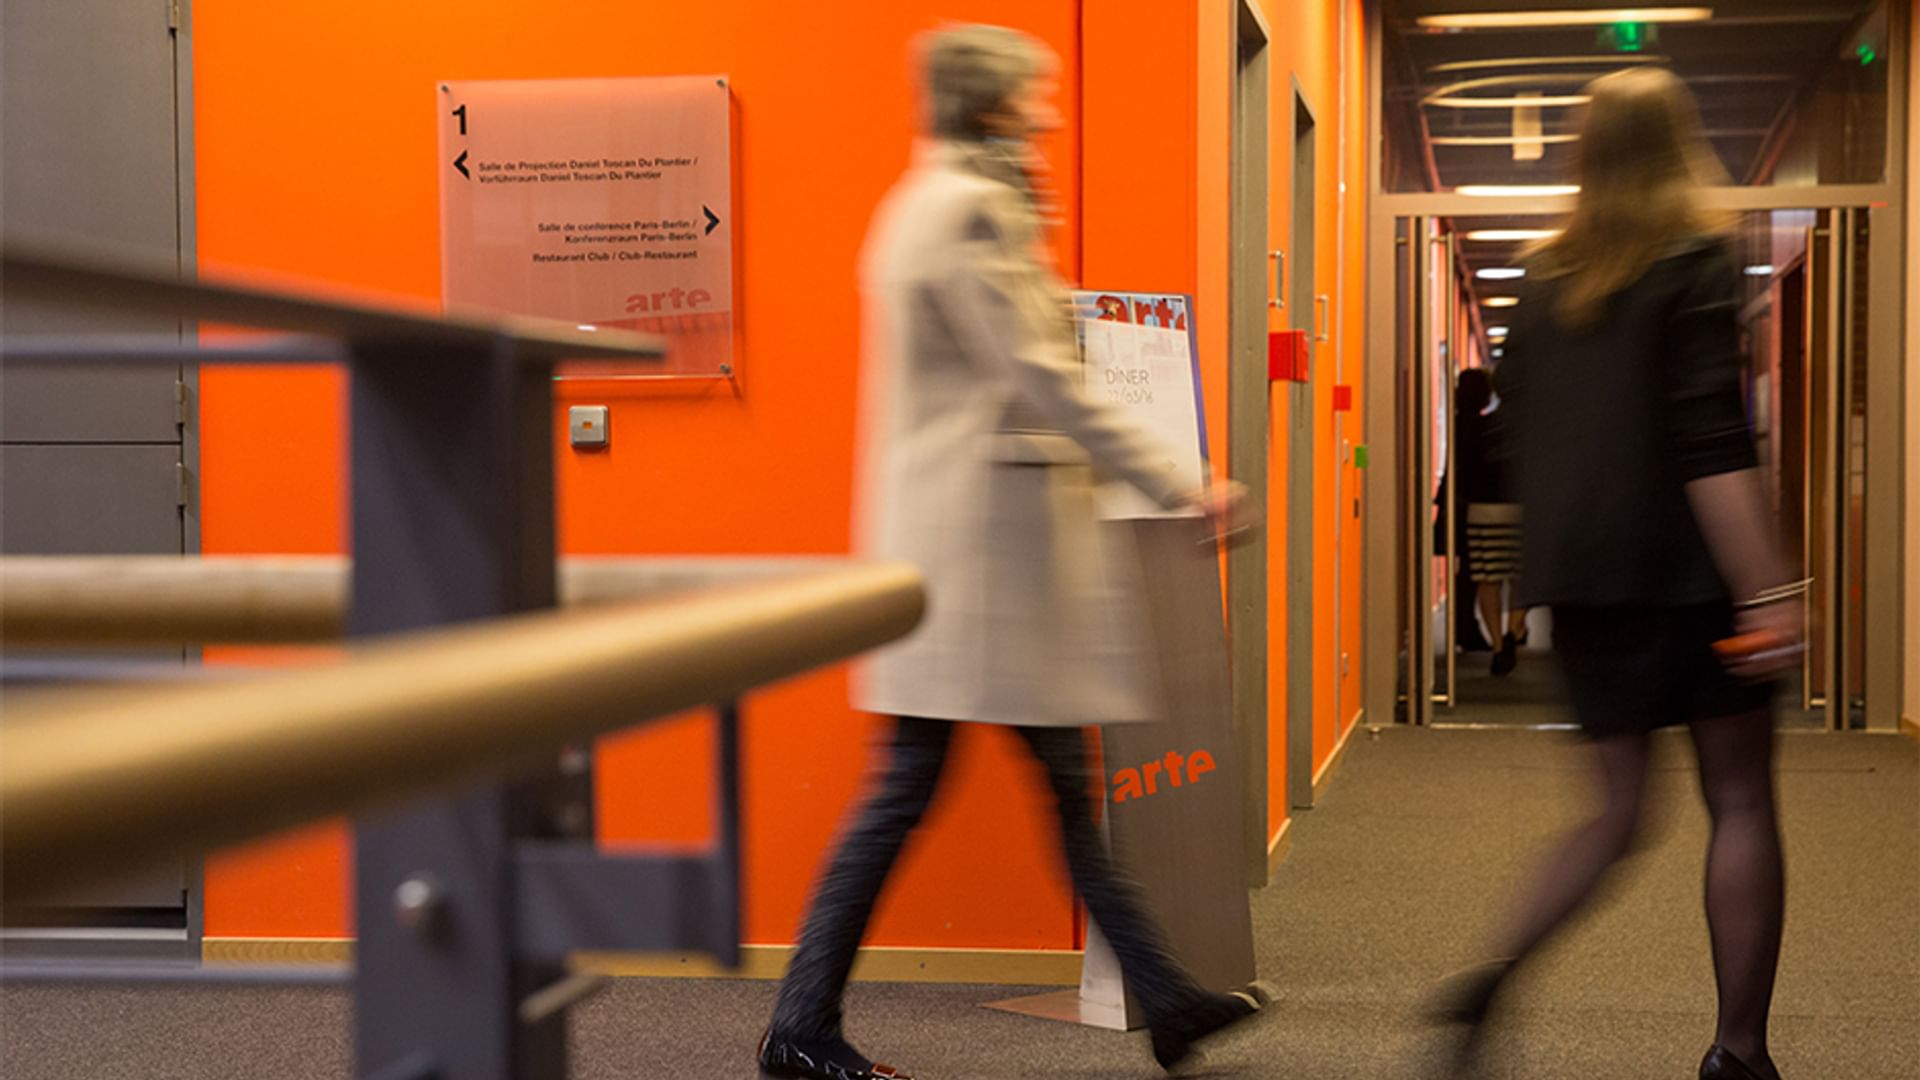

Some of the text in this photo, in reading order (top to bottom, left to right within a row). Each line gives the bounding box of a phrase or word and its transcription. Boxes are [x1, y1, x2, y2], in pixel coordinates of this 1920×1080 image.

[452, 105, 467, 135] 1
[479, 162, 501, 171] Salle
[504, 161, 516, 170] de
[518, 161, 567, 171] Projection
[569, 160, 600, 169] Daniel
[602, 158, 636, 168] Toscan
[638, 158, 653, 167] Du
[479, 170, 662, 183] Vorführraum Daniel Toscan Du Plantier
[538, 223, 560, 232] Salle
[563, 223, 575, 231] de
[634, 219, 690, 229] Paris-Berlin
[565, 231, 698, 243] Konferenzraum Paris-Berlin
[533, 253, 585, 262] Restaurant
[587, 251, 610, 261] Club
[618, 250, 697, 261] Club-Restaurant
[625, 287, 712, 313] arte
[1112, 748, 1216, 804] arte
